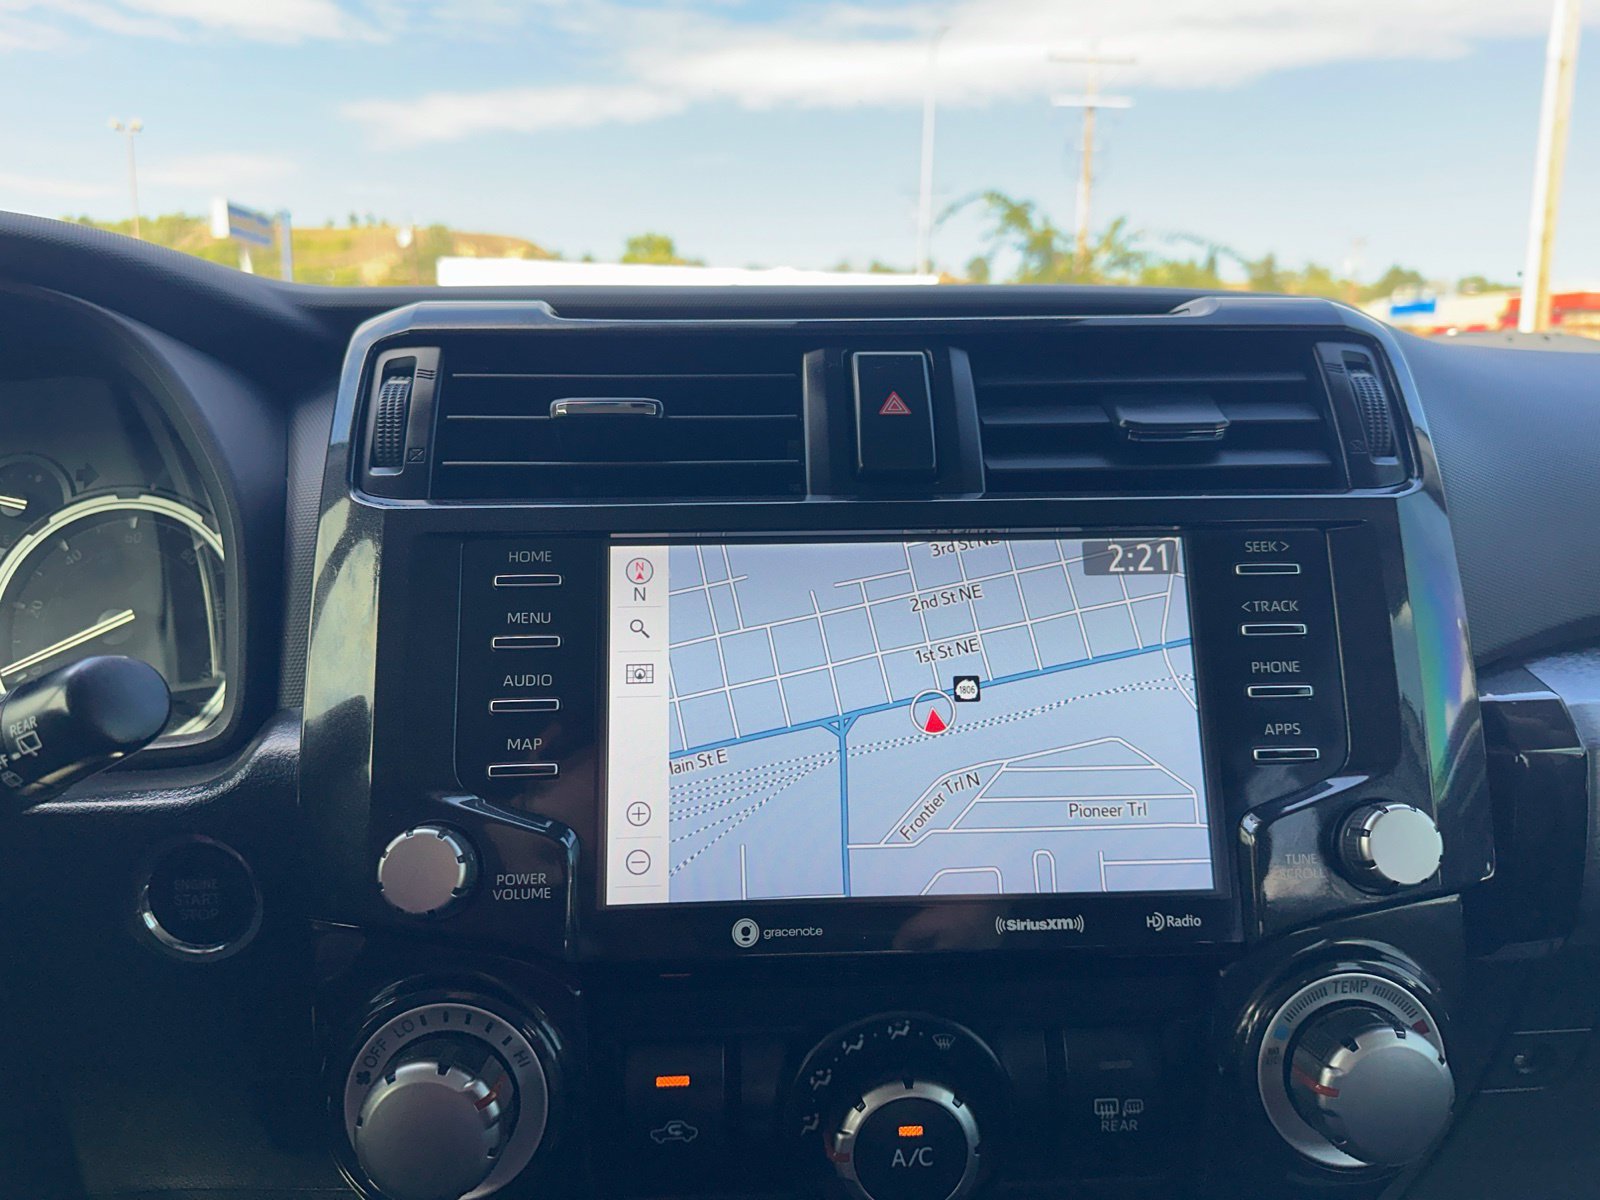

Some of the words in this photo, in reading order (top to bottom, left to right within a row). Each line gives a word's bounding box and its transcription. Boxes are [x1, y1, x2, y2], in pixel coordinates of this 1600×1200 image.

[930, 541, 956, 557] 3rd
[1245, 541, 1278, 552] SEEK
[508, 550, 553, 563] HOME
[1108, 543, 1168, 572] 2:21
[633, 587, 646, 601] N
[910, 593, 938, 612] 2nd
[940, 591, 957, 605] St
[958, 584, 983, 601] NE
[1252, 600, 1299, 612] TRACK
[507, 612, 552, 625] MENU
[915, 649, 936, 664] 1st
[937, 645, 954, 659] St
[955, 638, 980, 655] NE
[1251, 661, 1300, 674] PHONE
[503, 674, 553, 687] AUDIO
[959, 685, 976, 695] 1806
[9, 715, 38, 738] REAR
[1264, 723, 1301, 736] APPS
[507, 737, 543, 751] MAP
[669, 759, 694, 775] ain
[697, 753, 714, 769] St
[716, 748, 728, 764] E
[899, 792, 946, 841] Frontier
[941, 775, 965, 794] Trl
[965, 771, 981, 789] N
[1068, 804, 1122, 819] Pioneer
[1126, 802, 1147, 817] Trl
[1285, 853, 1318, 865] TUNE
[496, 873, 546, 886] POWER
[493, 887, 552, 901] VOLUME
[1166, 913, 1202, 928] Radio
[763, 926, 823, 939] gracenote
[1332, 979, 1369, 994] TEMP
[392, 1019, 415, 1039] LO
[363, 1038, 387, 1068] OFF
[1101, 1119, 1138, 1132] REAR
[891, 1147, 934, 1168] A/C
